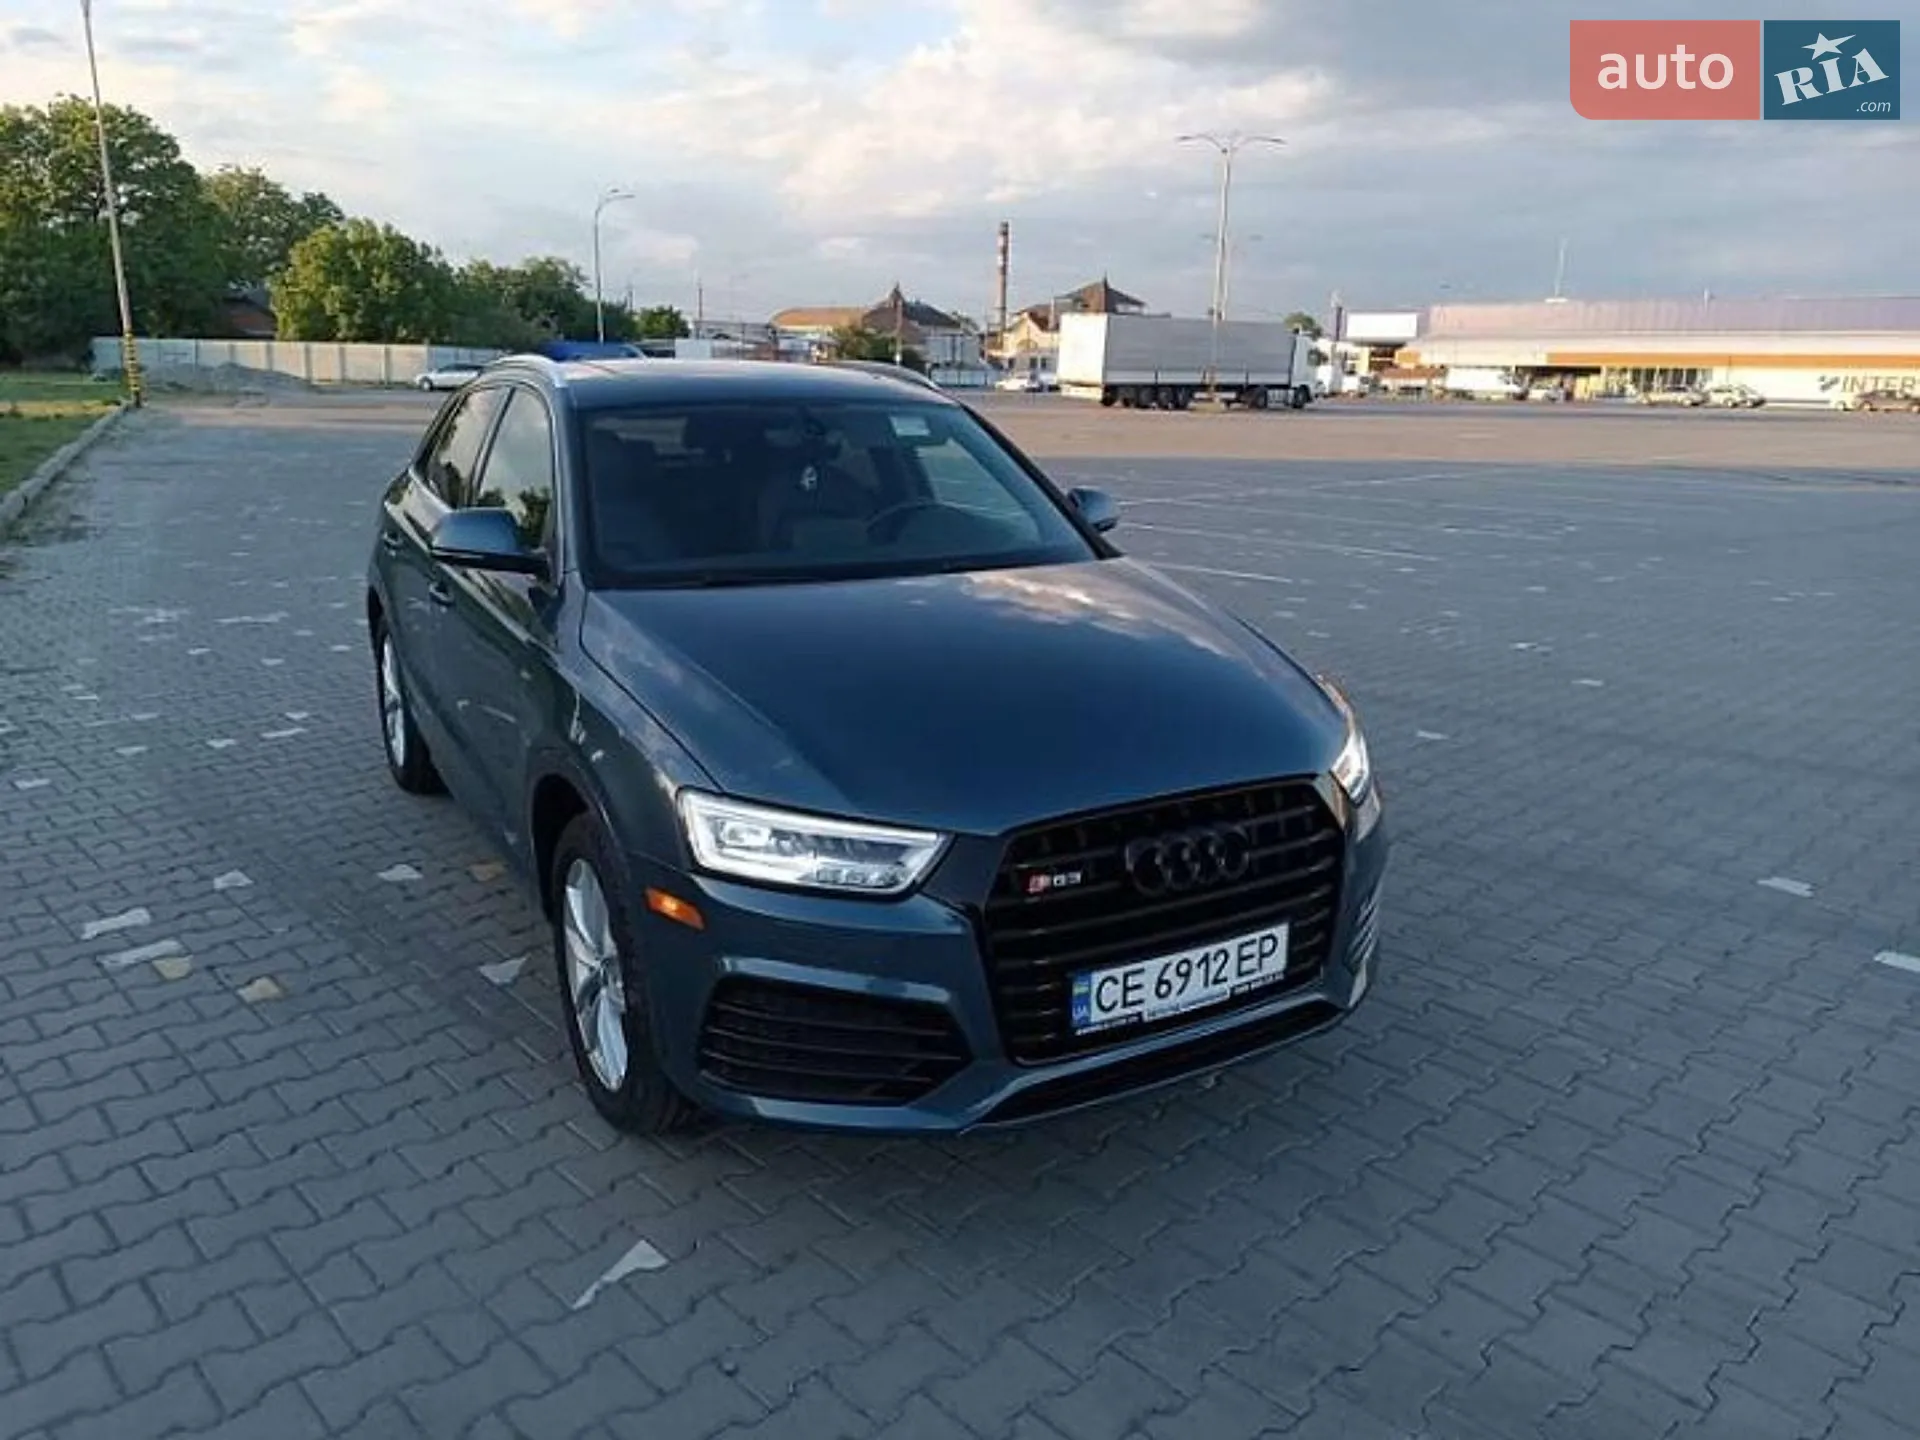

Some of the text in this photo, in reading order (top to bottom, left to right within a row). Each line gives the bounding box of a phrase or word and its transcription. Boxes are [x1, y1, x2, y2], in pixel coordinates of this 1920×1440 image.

[1841, 375, 1920, 392] INTER
[1096, 968, 1146, 1013] CE
[1155, 949, 1229, 999] 6912
[1237, 933, 1279, 977] EP
